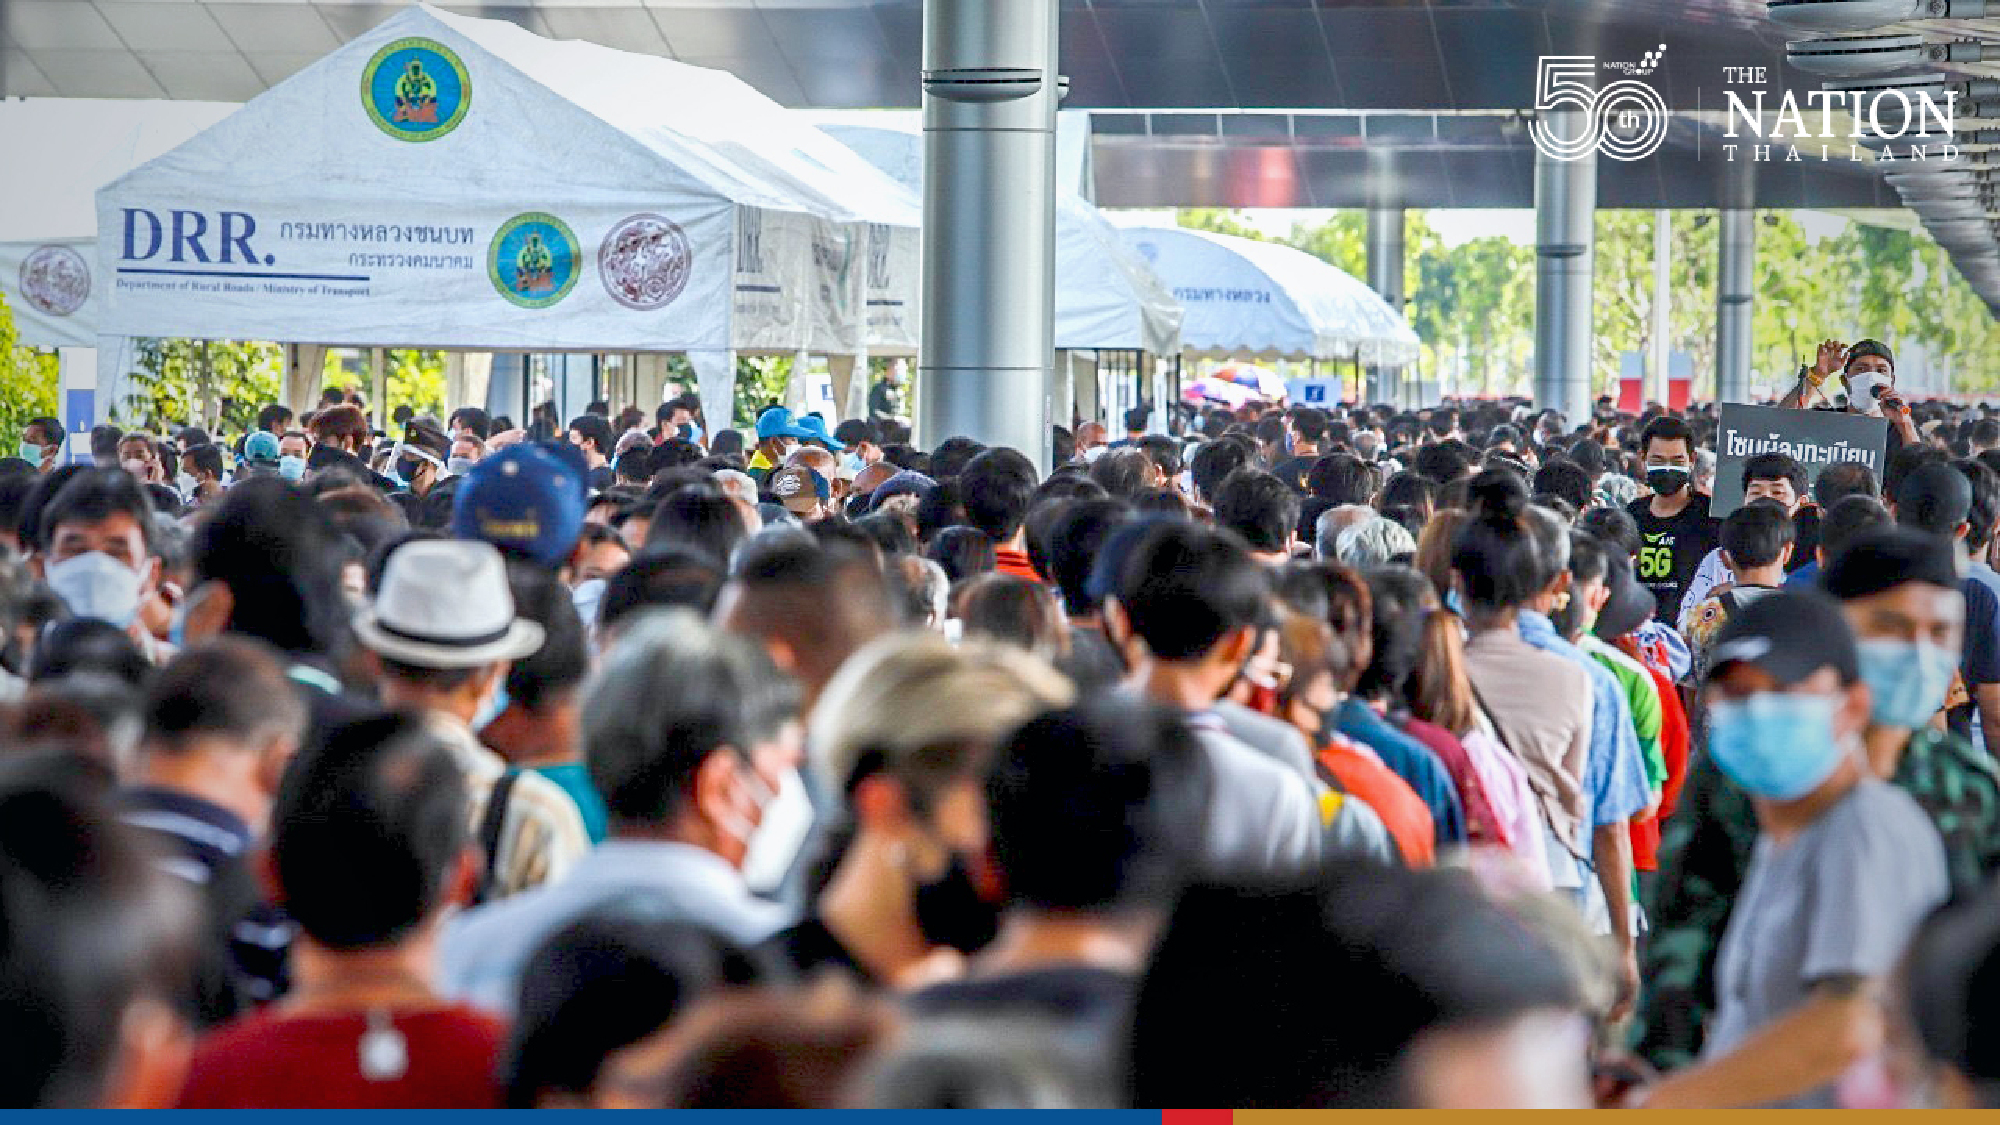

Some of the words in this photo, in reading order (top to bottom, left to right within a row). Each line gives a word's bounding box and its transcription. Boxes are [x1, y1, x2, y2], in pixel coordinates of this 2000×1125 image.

[119, 207, 276, 266] DRR.
[280, 221, 474, 245] กรมทางหลวงชนบท
[116, 277, 176, 292] Department
[179, 280, 190, 290] of
[191, 280, 221, 292] Rural
[263, 283, 305, 295] Ministry
[321, 284, 370, 298] Transport
[1640, 547, 1671, 577] 5G
